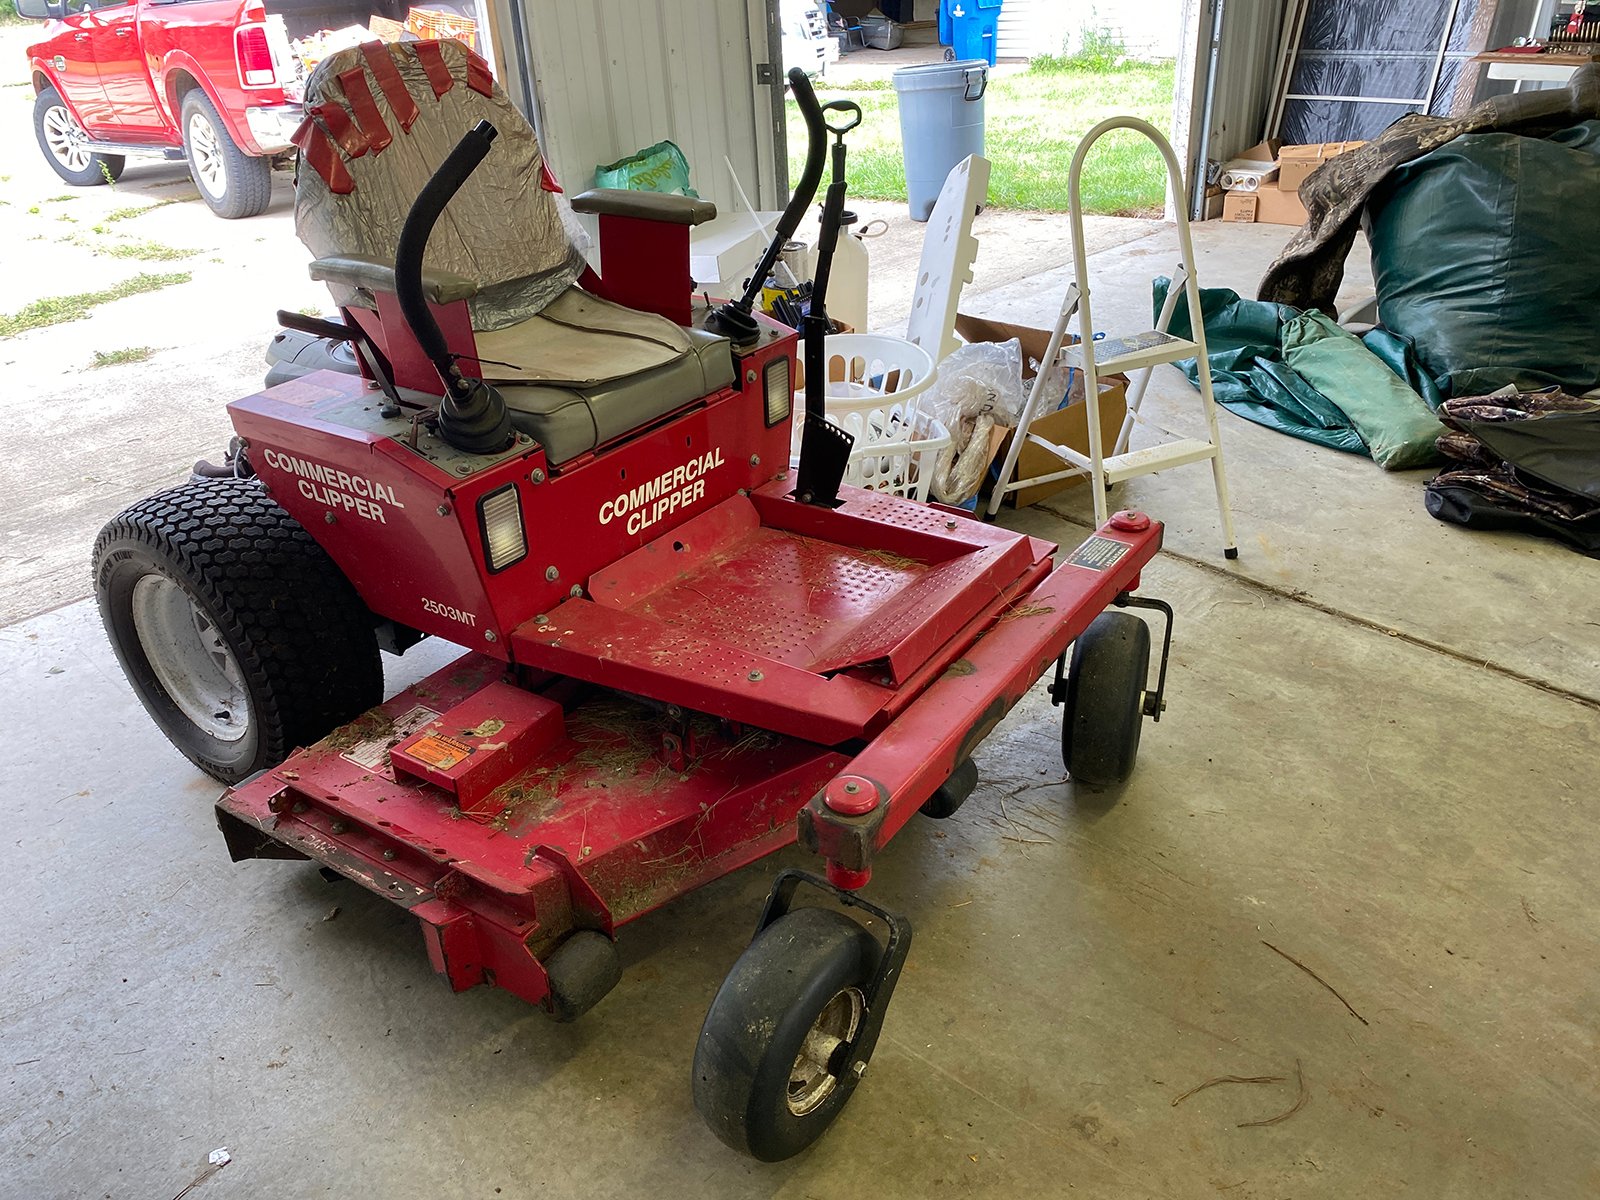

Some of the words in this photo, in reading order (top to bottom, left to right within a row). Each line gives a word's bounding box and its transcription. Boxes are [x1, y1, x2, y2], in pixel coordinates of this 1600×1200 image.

[263, 448, 405, 509] COMMERCIAL
[297, 479, 387, 525] CLIPPER
[598, 446, 725, 525] COMMERCIAL
[626, 478, 706, 536] CLIPPER
[421, 597, 476, 627] 2503MT
